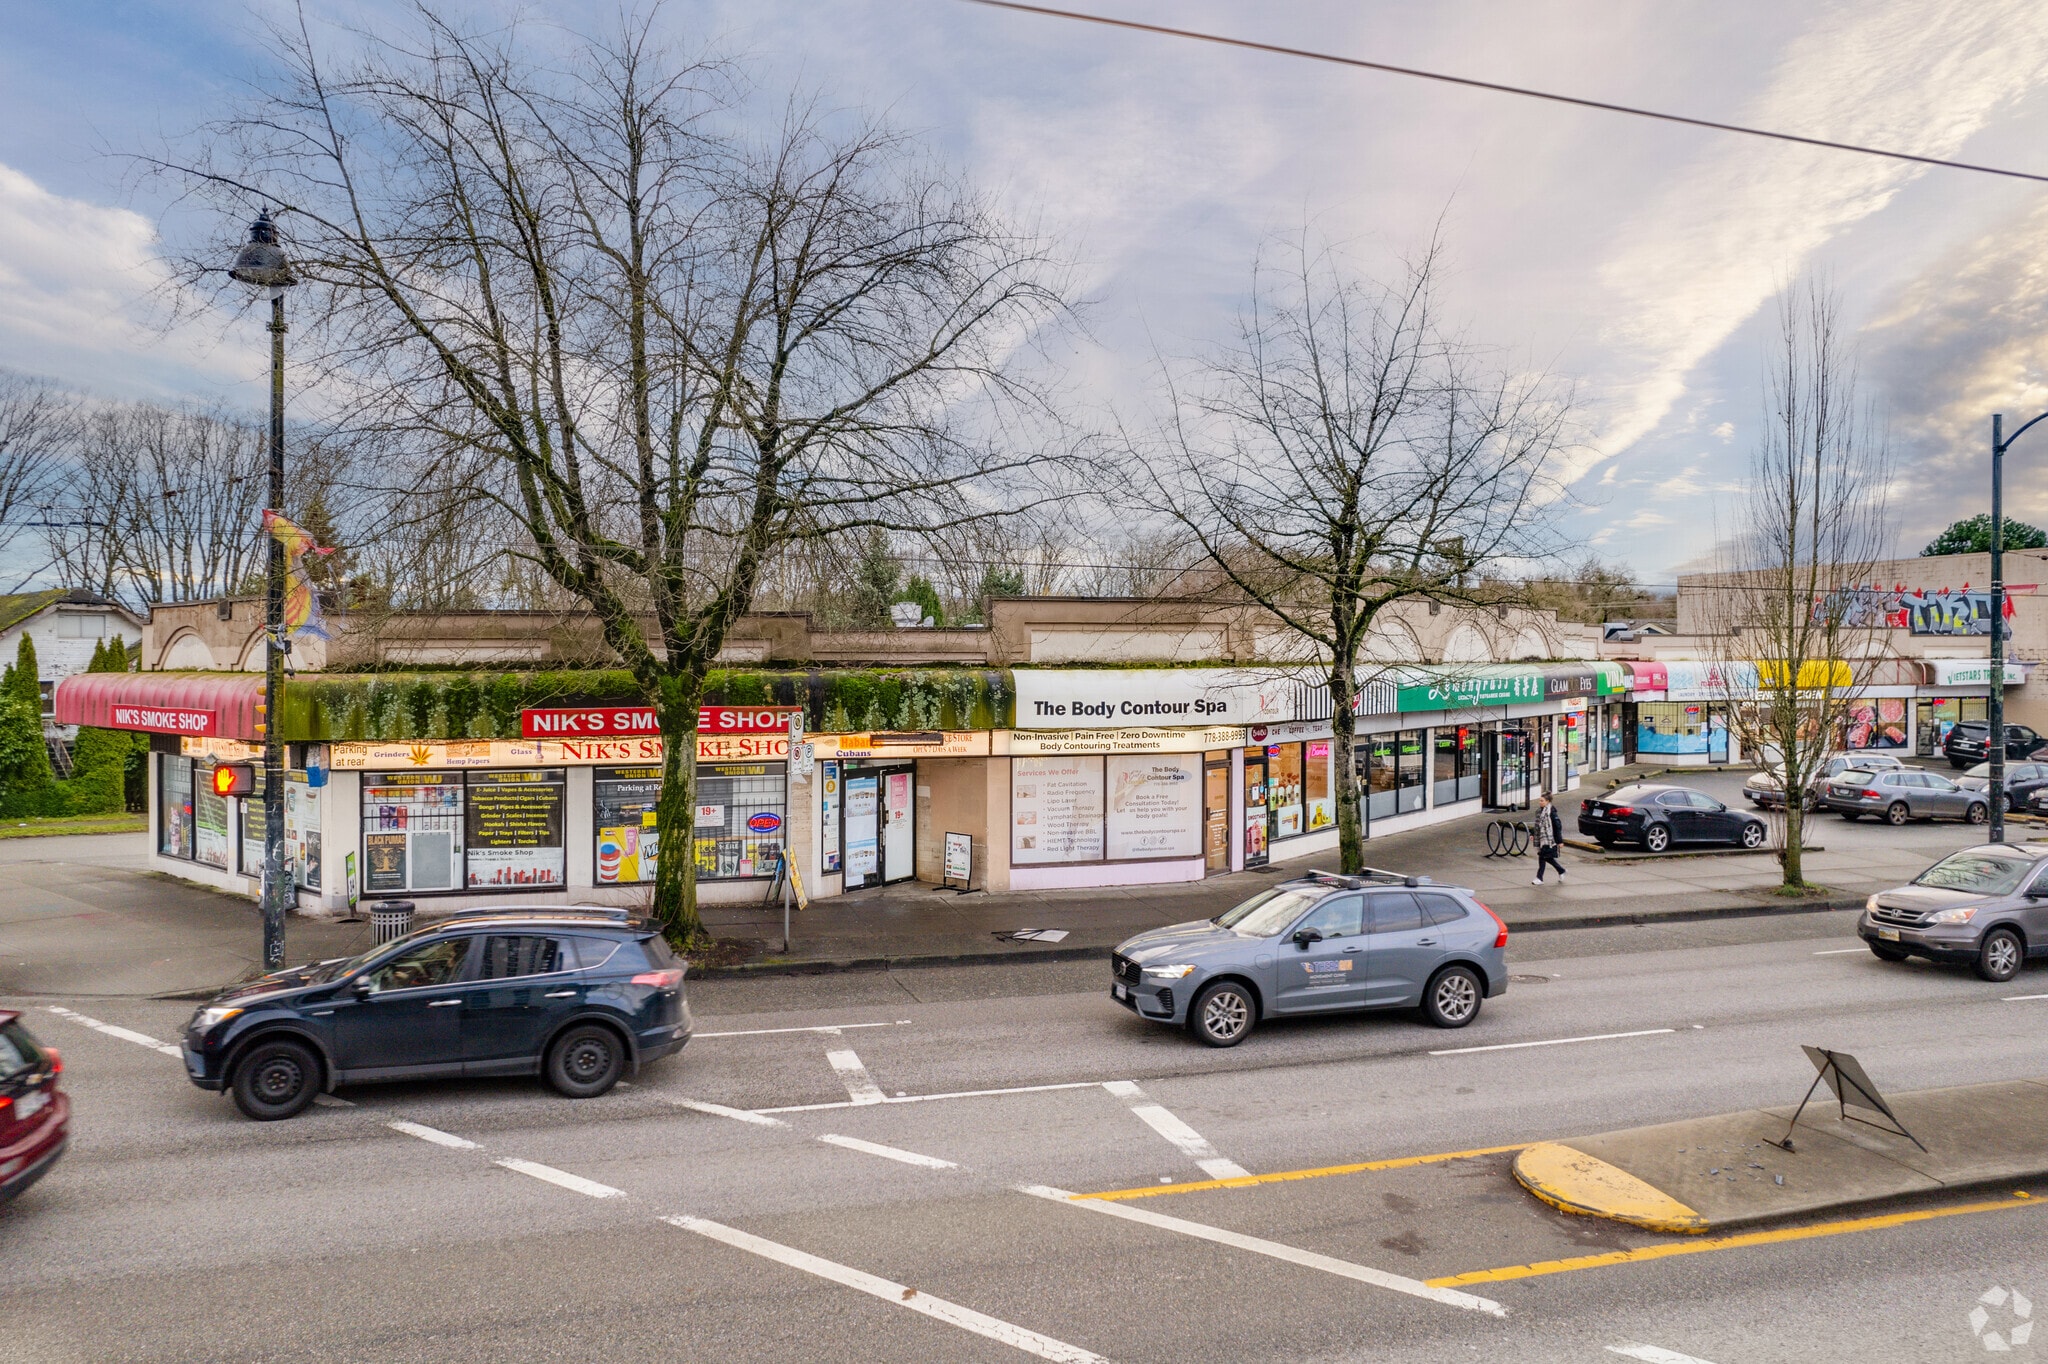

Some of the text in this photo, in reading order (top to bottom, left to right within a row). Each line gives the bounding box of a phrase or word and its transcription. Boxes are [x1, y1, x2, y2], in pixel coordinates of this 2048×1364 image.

[1606, 670, 1624, 688] VINA
[1983, 669, 2006, 680] TRL
[1580, 676, 1592, 690] EYES
[1034, 698, 1227, 719] The Body Contour Spa
[116, 708, 208, 731] NIK'S SMOKE SHOP
[533, 711, 790, 732] NIK'S SME SHOP
[952, 734, 972, 742] STORE
[1013, 732, 1069, 741] Non-Invasive
[1075, 732, 1094, 740] Pain
[1096, 732, 1115, 740] Free
[1120, 731, 1140, 739] Zero
[334, 745, 368, 756] Parking
[560, 742, 630, 760] NIK'S
[740, 738, 805, 756] SHO
[1040, 741, 1160, 751] Body Contouring Treatments
[347, 758, 365, 766] rear
[748, 766, 765, 774] WU
[523, 773, 542, 781] WU
[701, 807, 716, 815] 19+
[749, 819, 779, 828] OPEN
